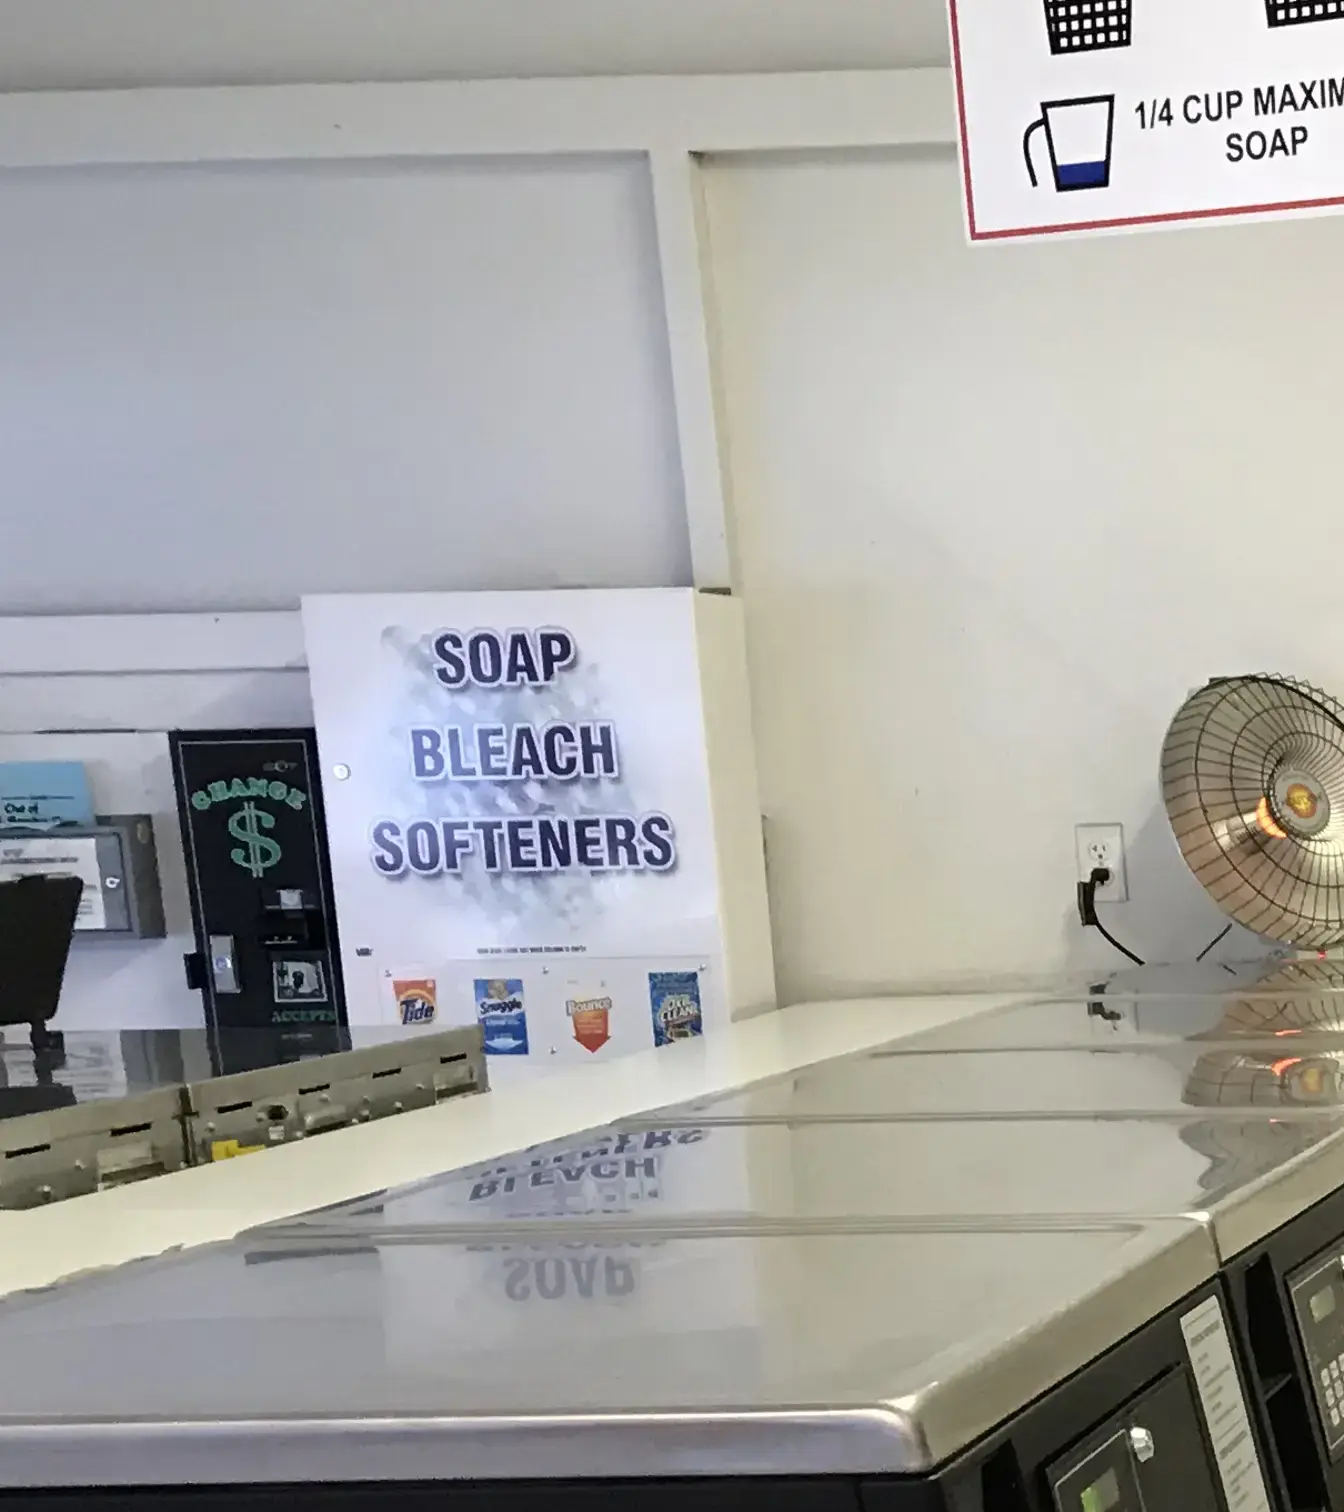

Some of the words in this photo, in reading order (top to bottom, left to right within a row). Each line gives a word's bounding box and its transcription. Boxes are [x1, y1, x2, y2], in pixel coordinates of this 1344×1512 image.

[1135, 97, 1175, 130] 1/4
[1183, 90, 1243, 124] CUP
[1226, 126, 1309, 163] SOAP
[433, 632, 573, 686] SOAP
[411, 724, 616, 777] BLEACH
[191, 776, 308, 811] CHANGE
[372, 816, 674, 872] SOFTENERS
[272, 1010, 337, 1023] ACCEPTS
[400, 999, 434, 1025] Tide
[479, 999, 523, 1015] Snuggle
[566, 996, 613, 1016] Bounce
